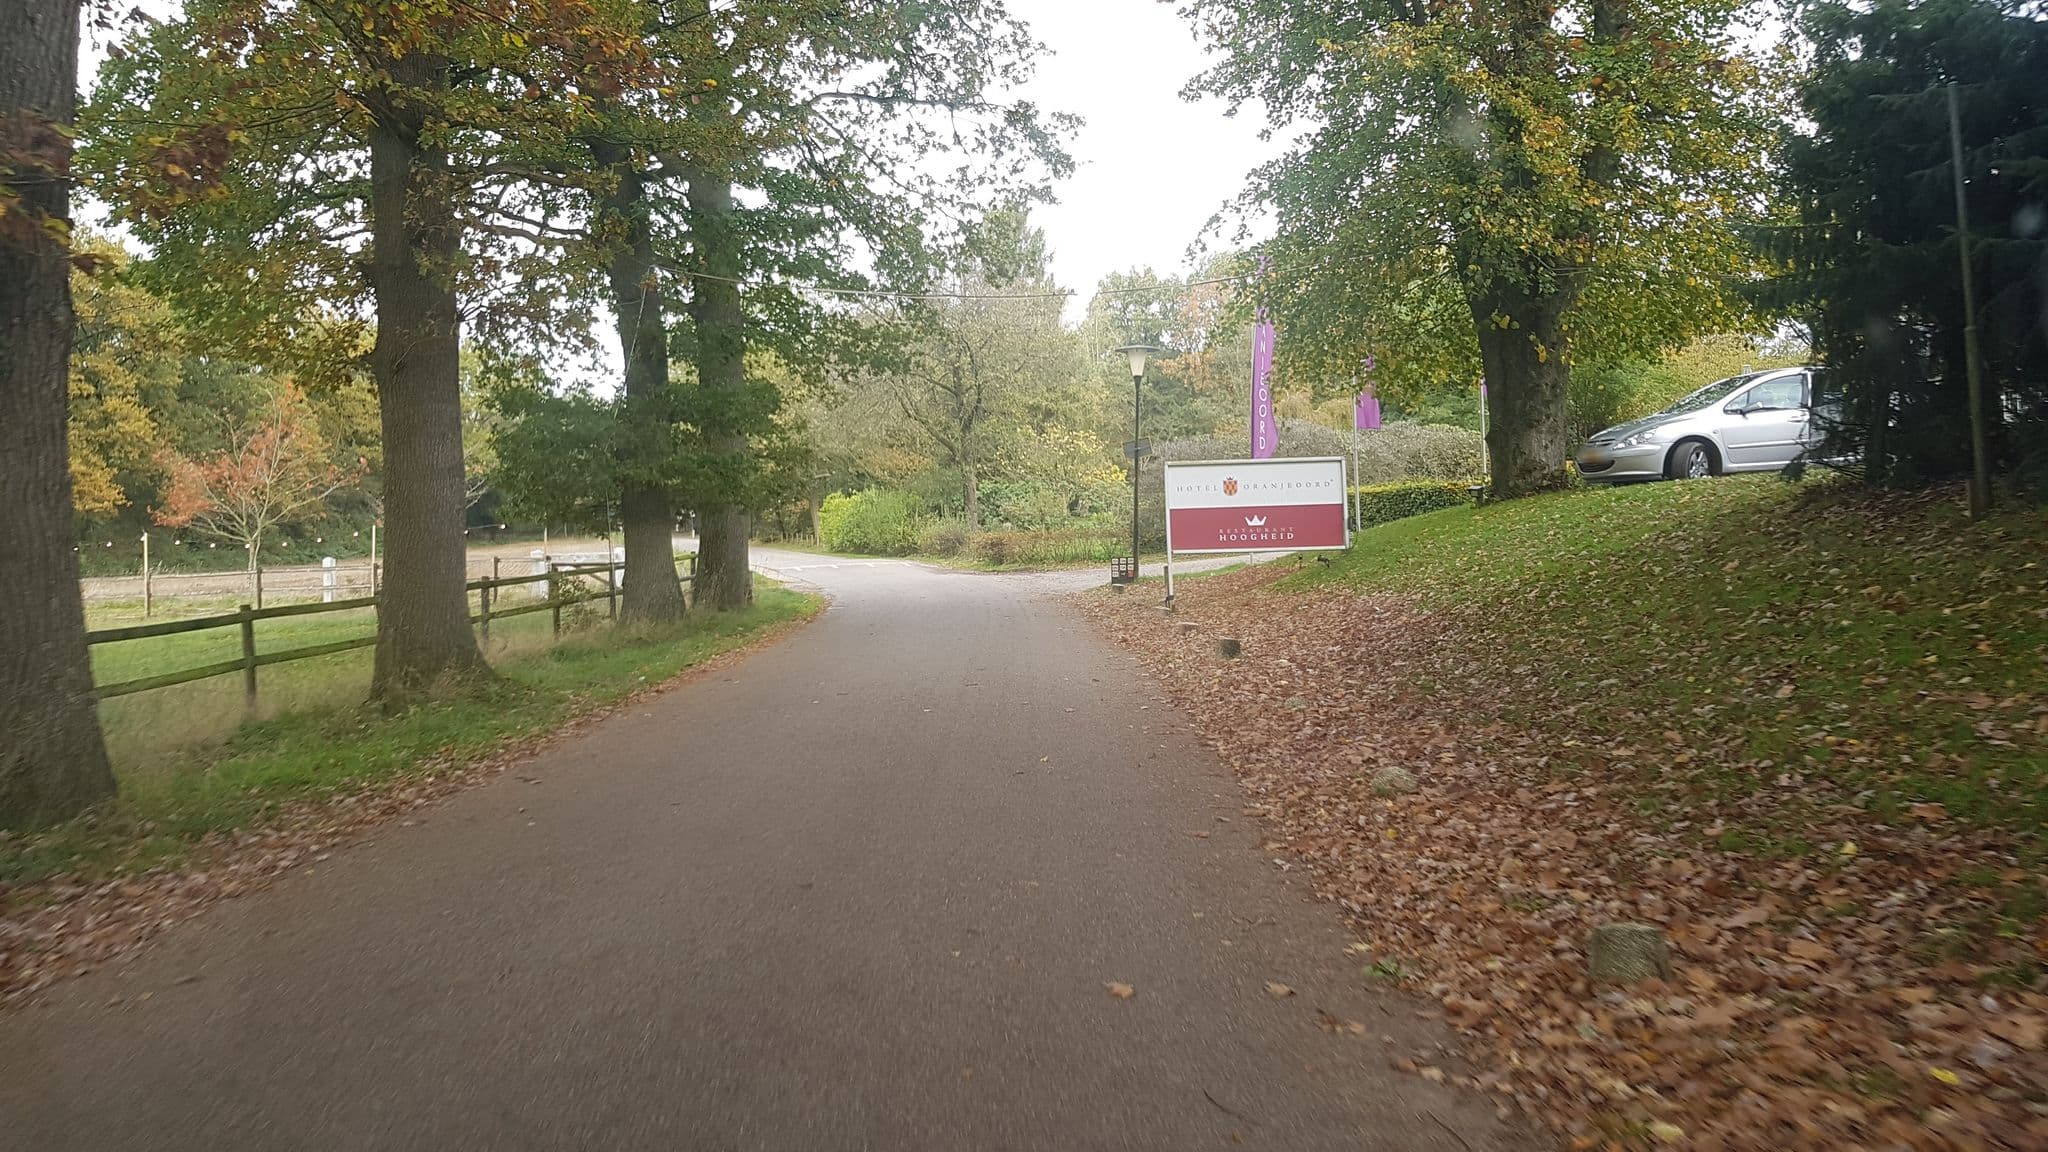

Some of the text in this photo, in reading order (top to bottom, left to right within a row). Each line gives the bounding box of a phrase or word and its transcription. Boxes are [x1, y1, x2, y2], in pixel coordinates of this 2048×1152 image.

[1176, 481, 1331, 492] HOTEL ORANJEOORD
[1219, 532, 1294, 541] HOOGHEID
